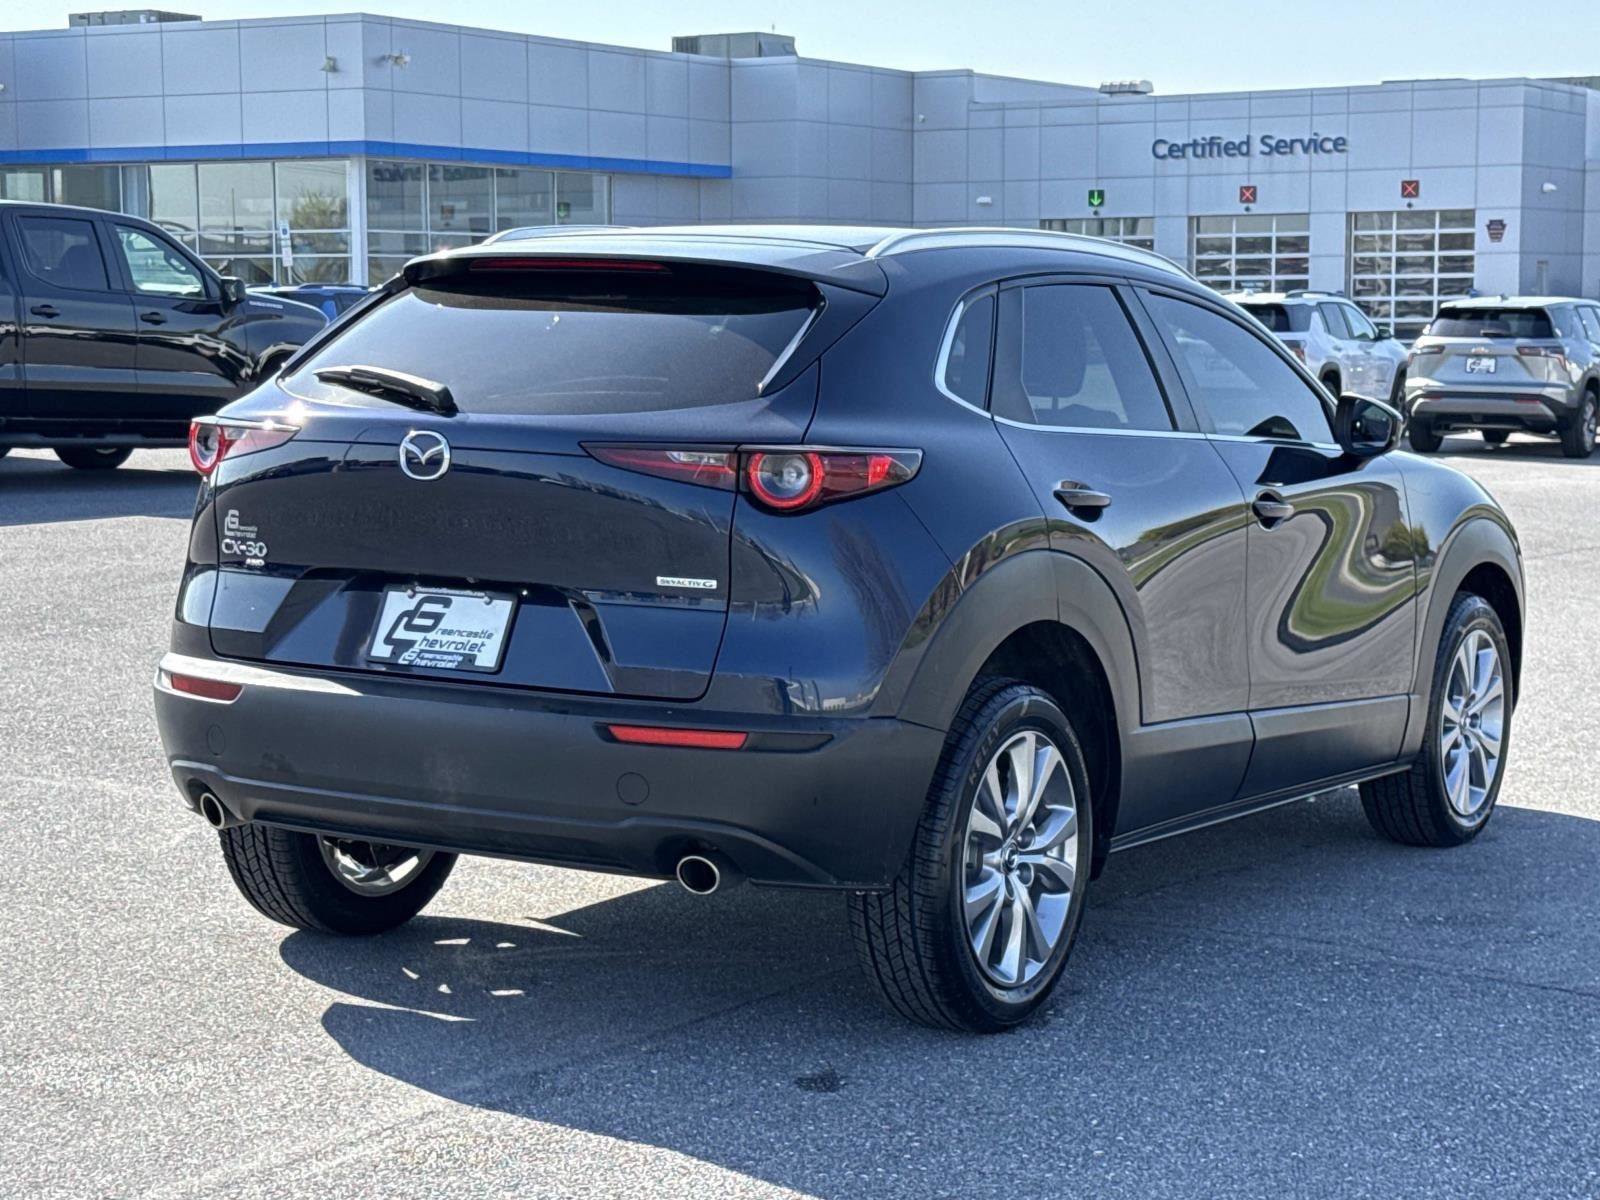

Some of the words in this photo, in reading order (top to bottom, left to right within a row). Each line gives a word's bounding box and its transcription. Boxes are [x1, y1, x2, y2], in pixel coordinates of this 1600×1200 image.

[1152, 135, 1251, 160] Certified
[1259, 132, 1348, 156] Service
[221, 538, 267, 557] CX-30
